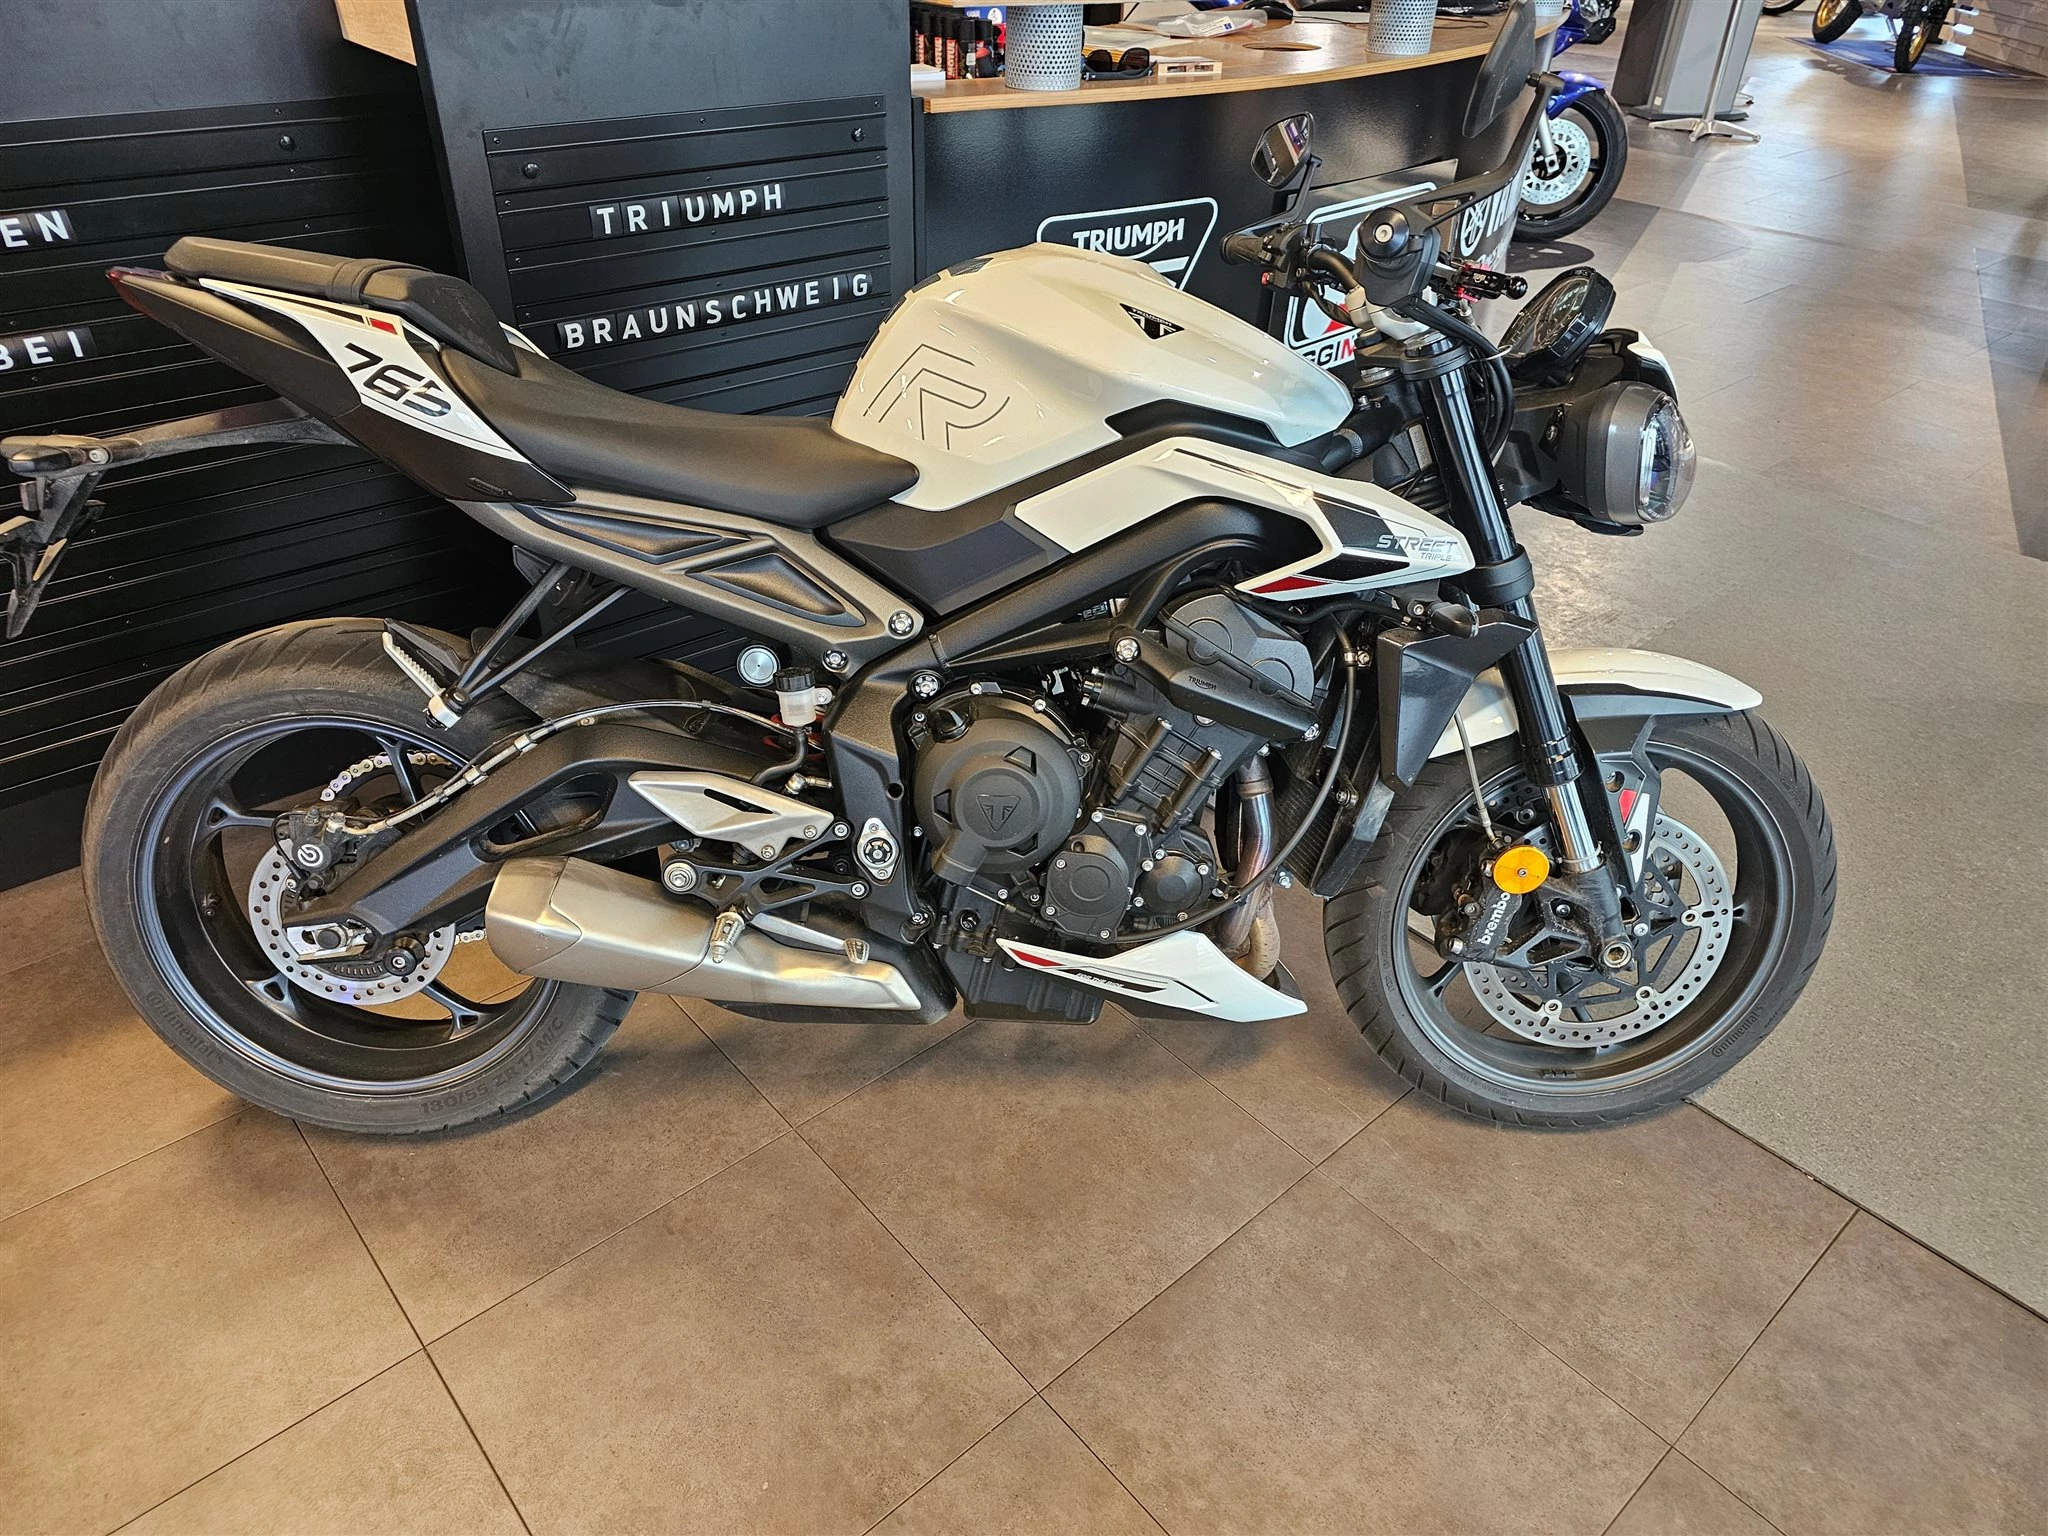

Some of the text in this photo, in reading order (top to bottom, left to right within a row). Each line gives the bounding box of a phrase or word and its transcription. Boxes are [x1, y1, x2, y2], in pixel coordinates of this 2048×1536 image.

[946, 40, 956, 77] MOTUL
[597, 183, 783, 235] TRIUMPH
[0, 210, 70, 248] EN
[1072, 217, 1186, 252] TRIUMPH
[563, 273, 869, 349] BRAUNSCHWEIG
[344, 342, 452, 418] 765
[1376, 534, 1458, 554] STREET
[1420, 552, 1452, 562] TRIPLE
[1188, 675, 1217, 690] TRIUMPH
[1477, 892, 1511, 945] brembo
[1711, 1011, 1760, 1057] Continental
